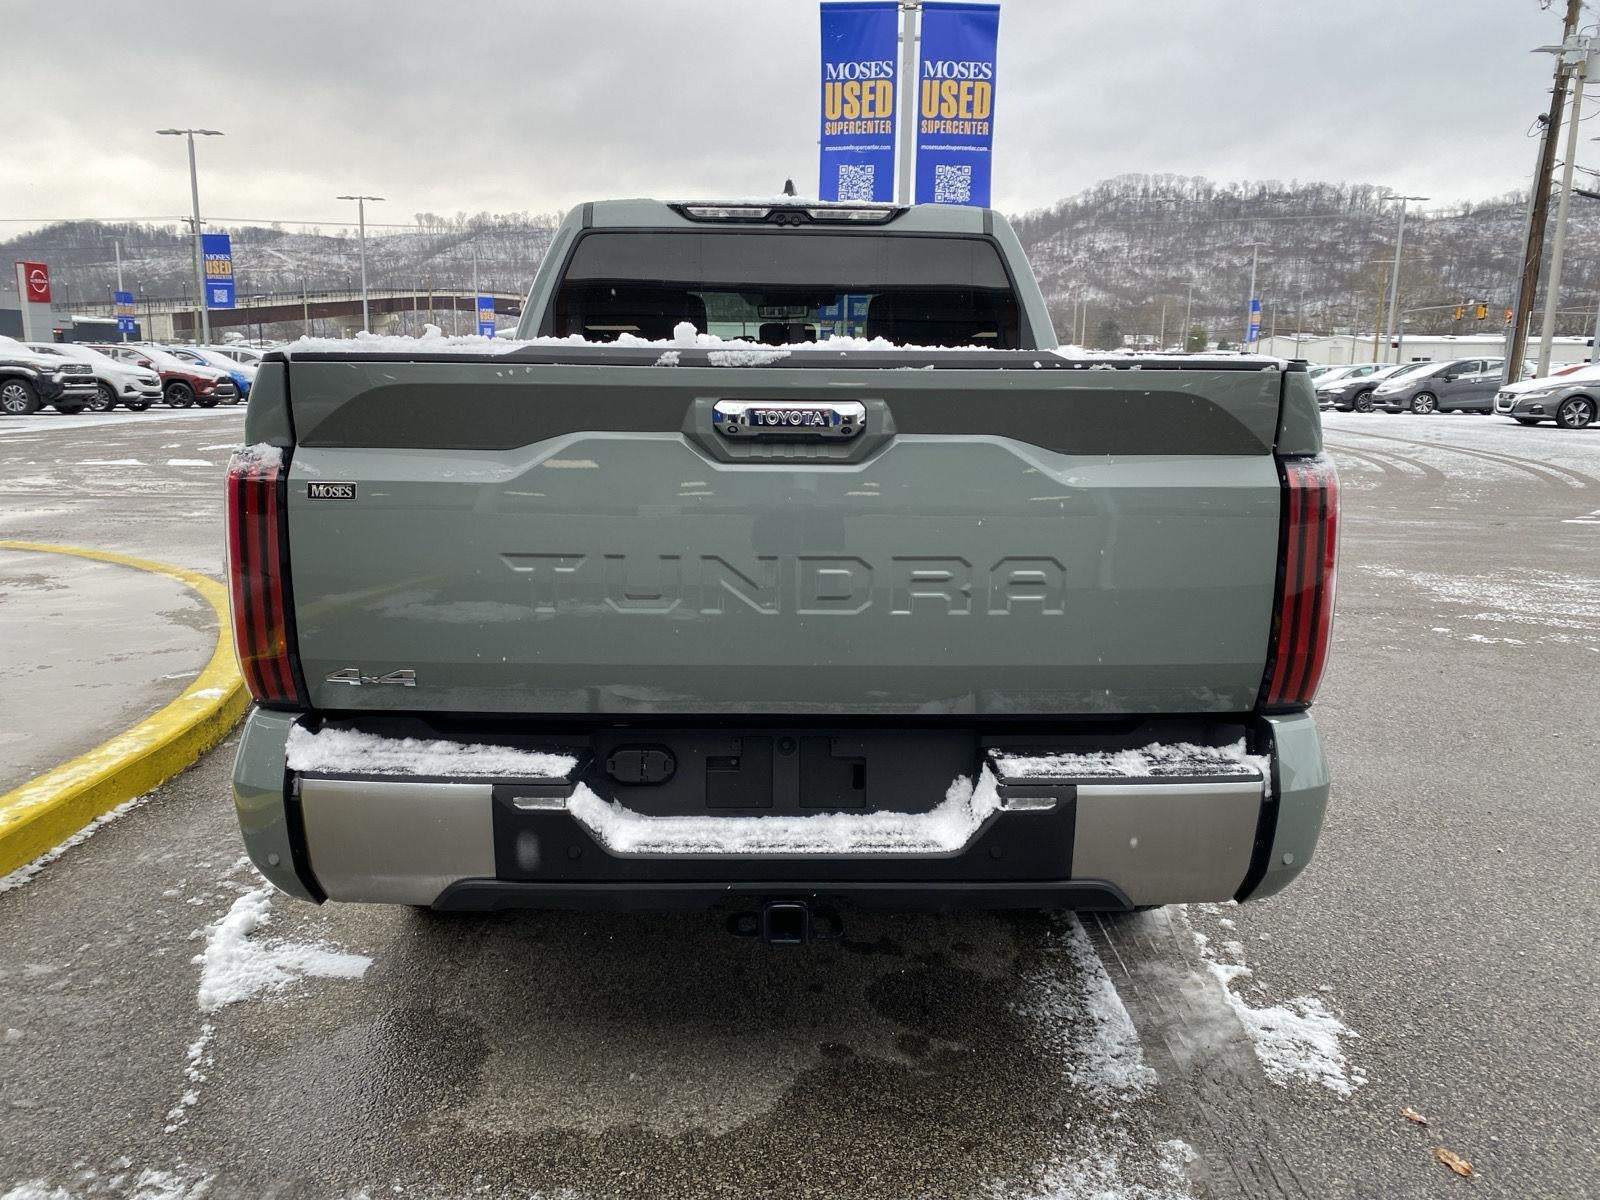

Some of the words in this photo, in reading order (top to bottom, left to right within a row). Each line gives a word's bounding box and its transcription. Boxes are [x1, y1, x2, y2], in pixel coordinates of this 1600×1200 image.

[826, 61, 893, 80] MOSES
[923, 60, 992, 79] MOSES
[825, 80, 893, 120] USED
[921, 80, 991, 119] USED
[825, 120, 891, 135] SUPERCENTER
[921, 119, 988, 135] SUPERCENTER
[206, 261, 232, 274] USED
[755, 411, 825, 425] TOYOTA
[311, 484, 352, 498] MOSES
[500, 553, 1067, 616] TUNDRA
[325, 668, 416, 687] 4x4
